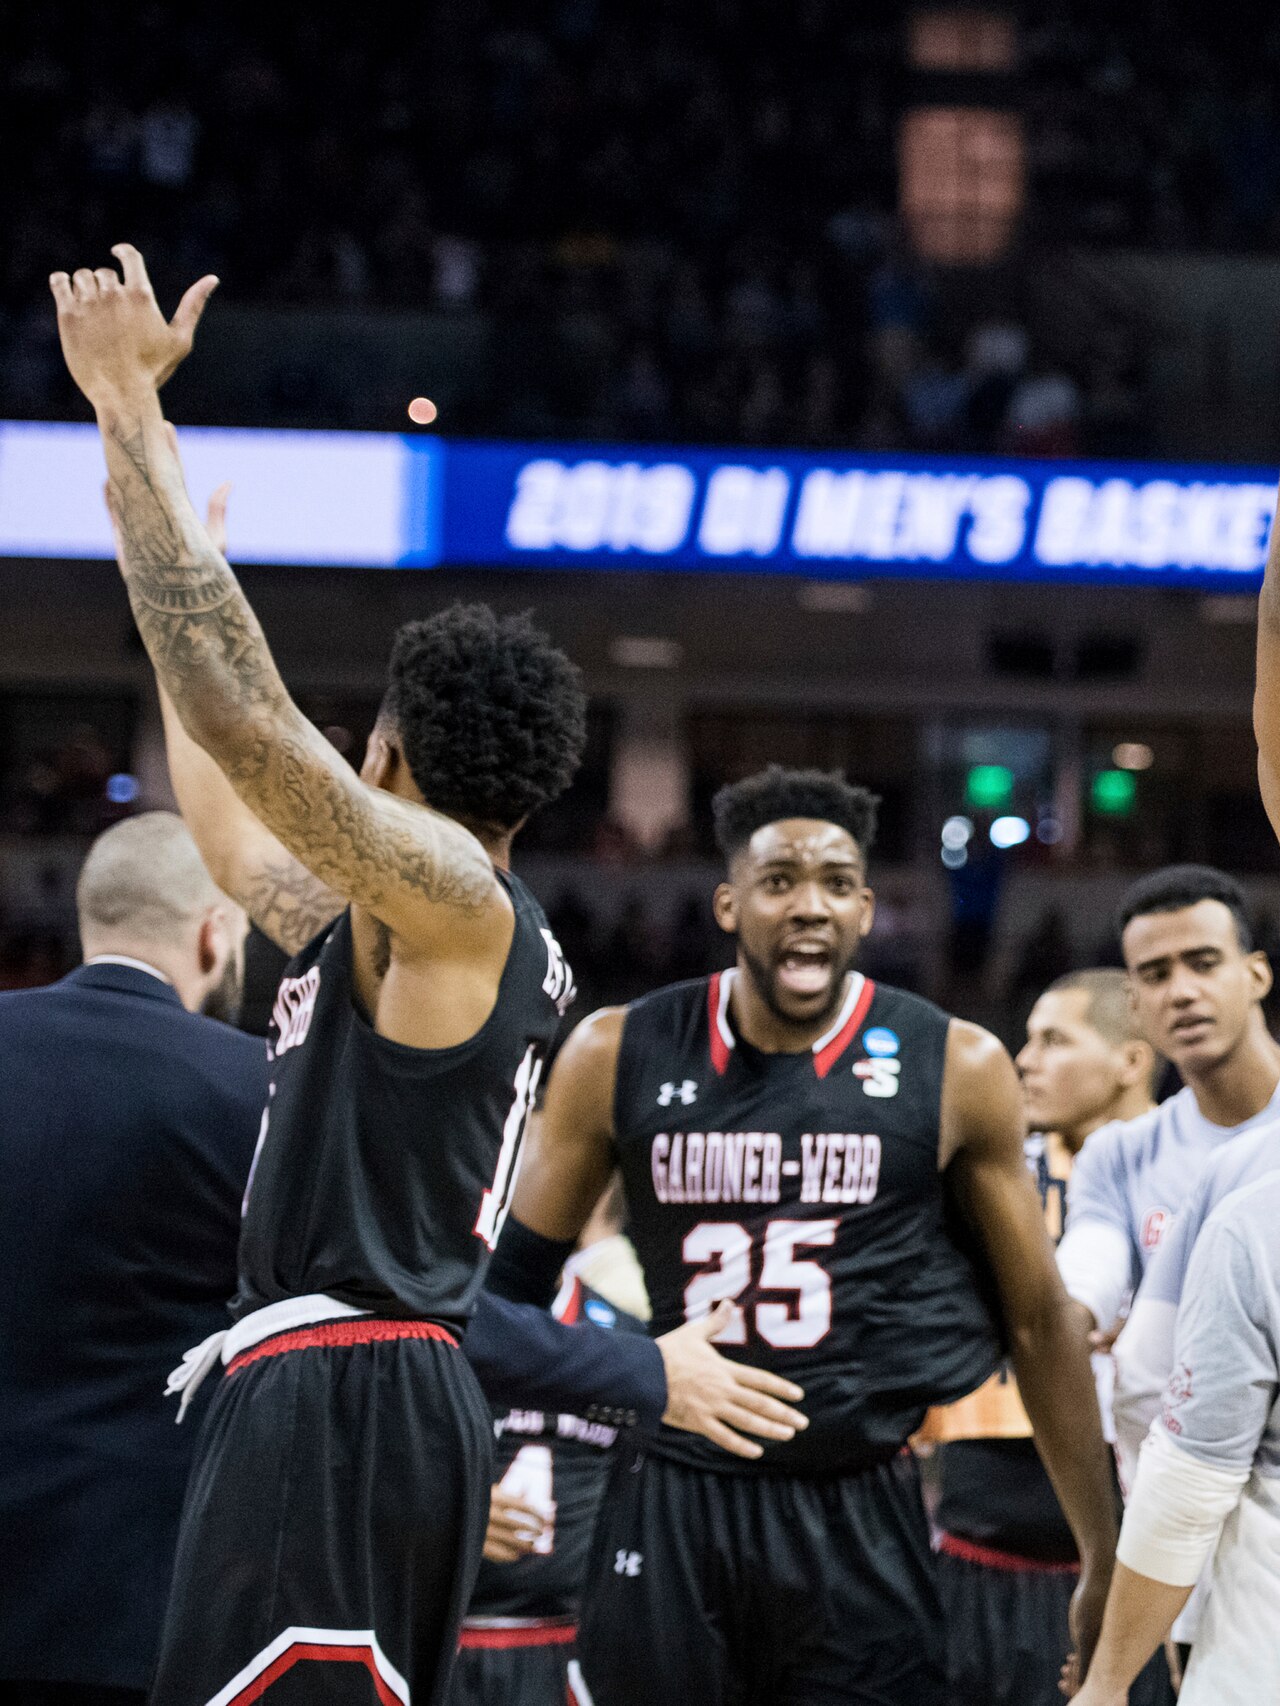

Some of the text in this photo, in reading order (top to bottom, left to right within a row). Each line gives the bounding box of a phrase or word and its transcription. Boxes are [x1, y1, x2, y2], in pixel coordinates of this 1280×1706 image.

[505, 458, 697, 555] 2019
[792, 467, 1032, 564] MEN'S
[651, 1131, 883, 1204] GARDNER-WEBB
[681, 1217, 842, 1349] 25
